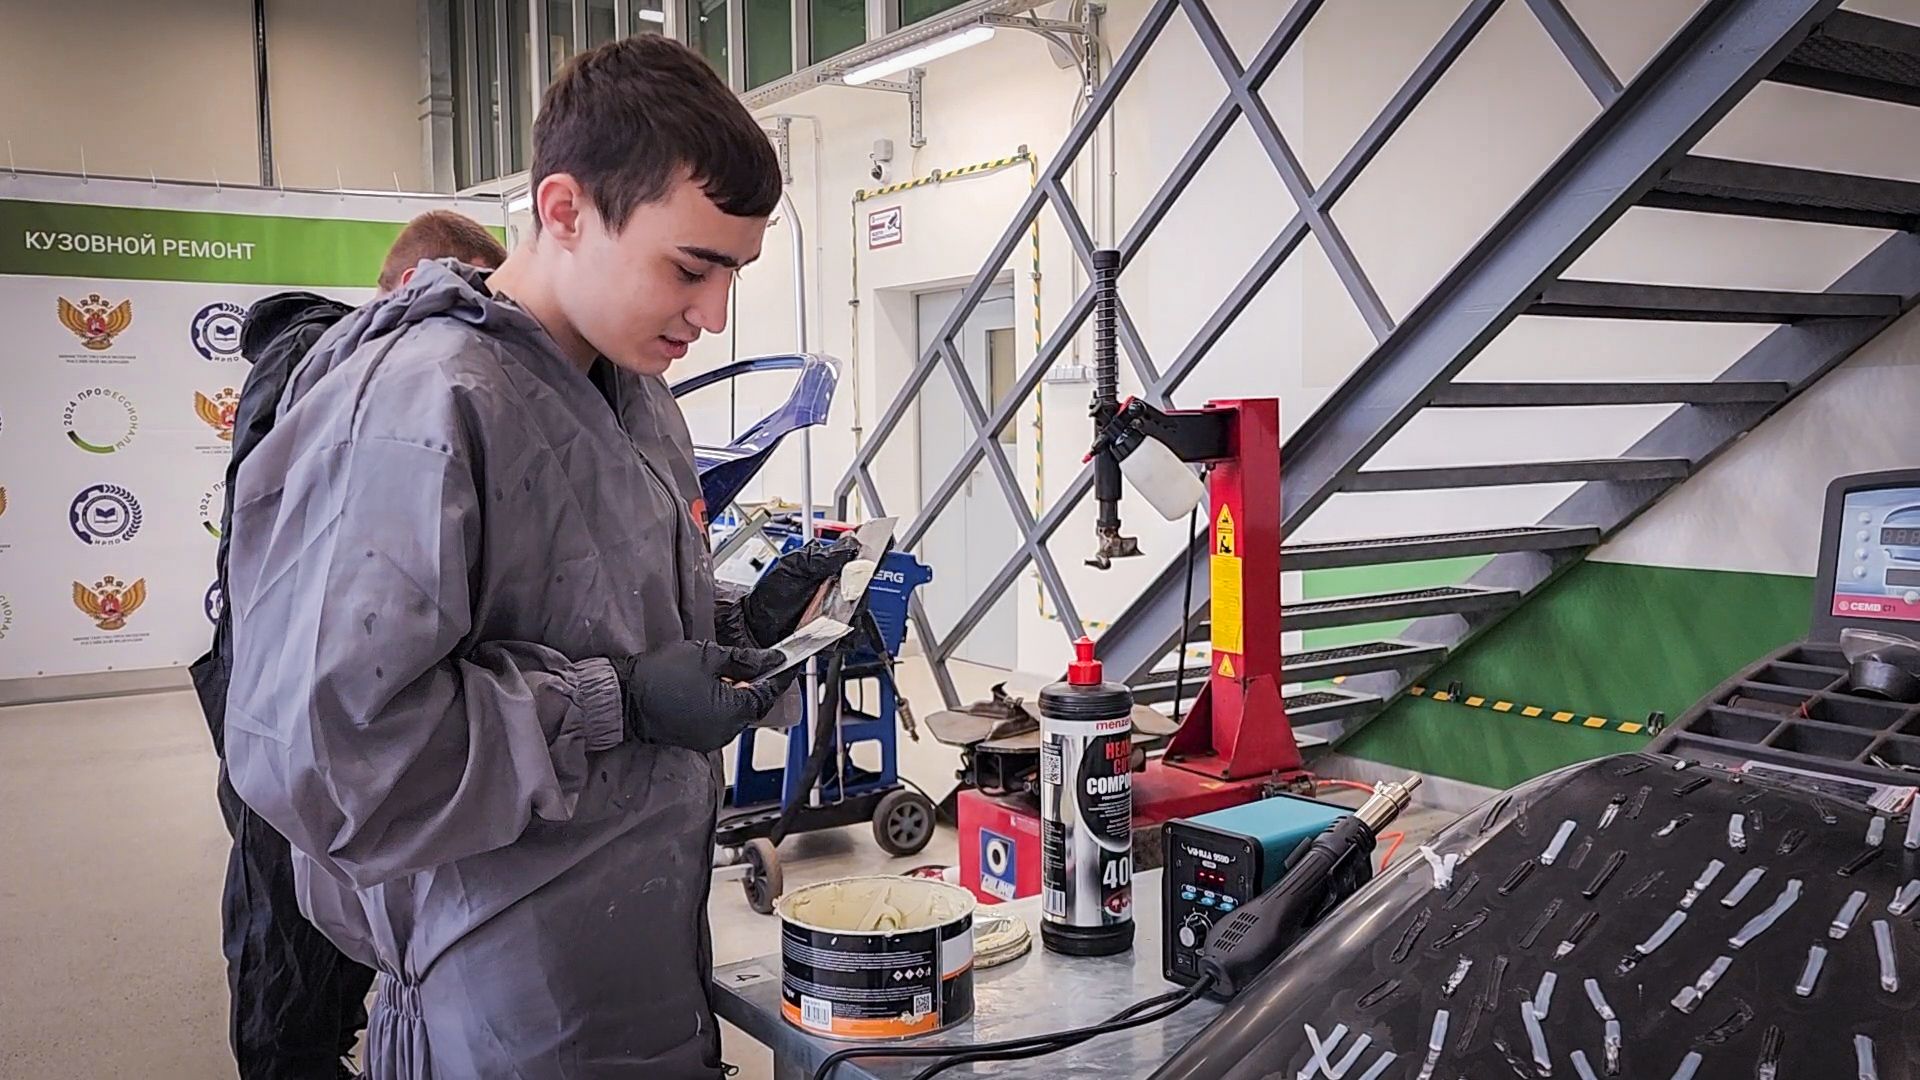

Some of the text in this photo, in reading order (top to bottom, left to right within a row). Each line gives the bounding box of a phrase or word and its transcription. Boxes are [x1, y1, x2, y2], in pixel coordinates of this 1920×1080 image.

[25, 231, 256, 260] КУЗОВНОЙ РЕМОНТ
[64, 388, 138, 450] 2024 ПРОФЕССИОНАЛЫ
[199, 492, 213, 516] 2024
[873, 569, 904, 584] ERG
[1850, 602, 1881, 612] CEMB
[1096, 718, 1131, 730] menze
[1086, 773, 1131, 795] COMPO
